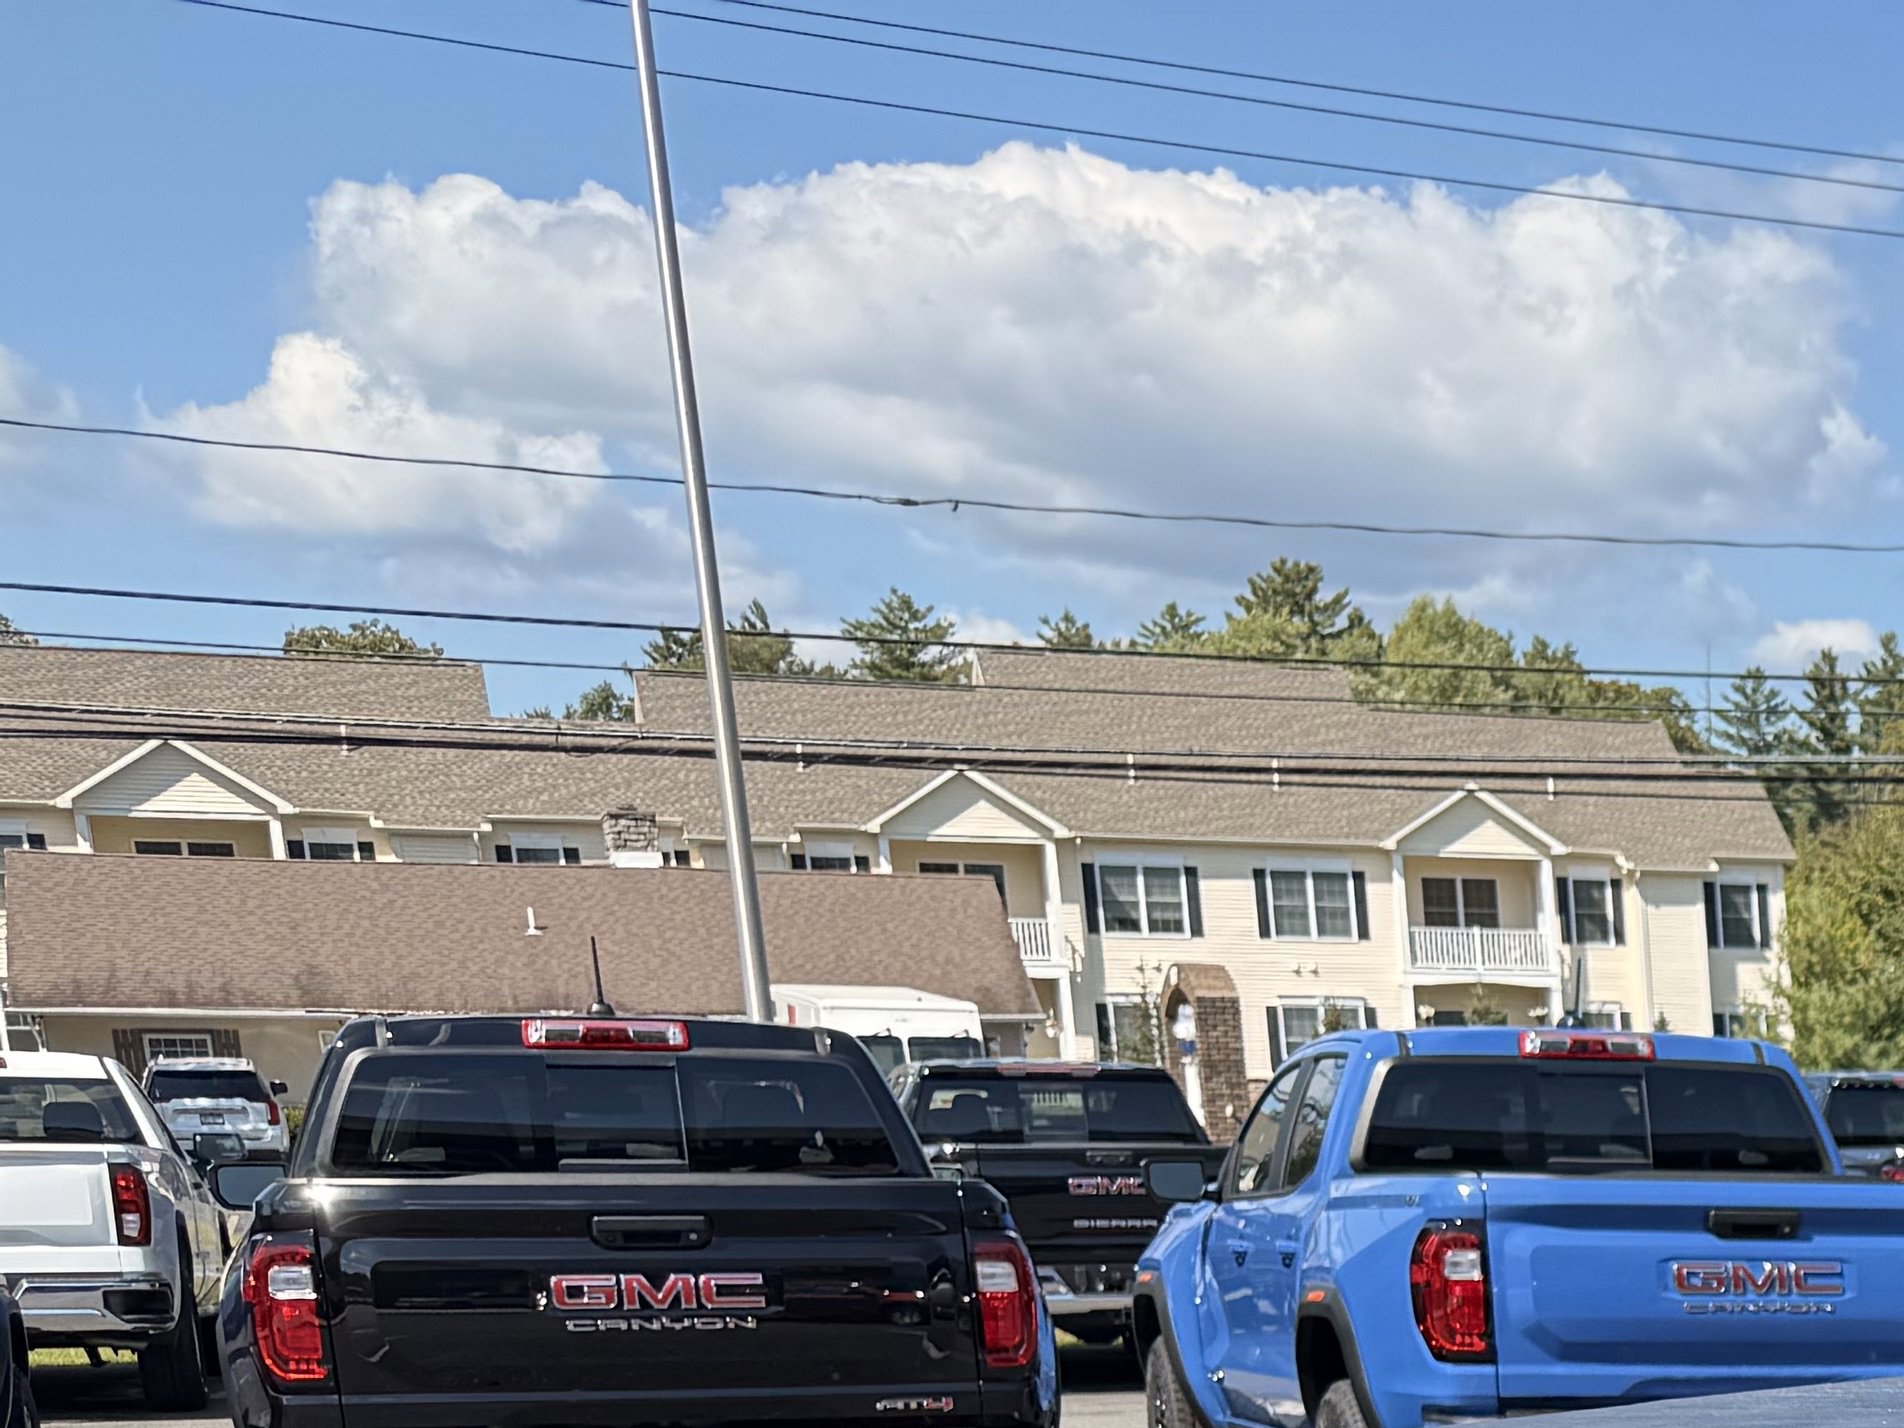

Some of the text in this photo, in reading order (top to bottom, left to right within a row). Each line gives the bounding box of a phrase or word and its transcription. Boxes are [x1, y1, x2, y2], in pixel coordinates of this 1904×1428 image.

[1672, 1259, 1843, 1295] GMC
[549, 1272, 767, 1311] GMC
[565, 1315, 758, 1332] CANYON
[875, 1396, 955, 1413] AT4
